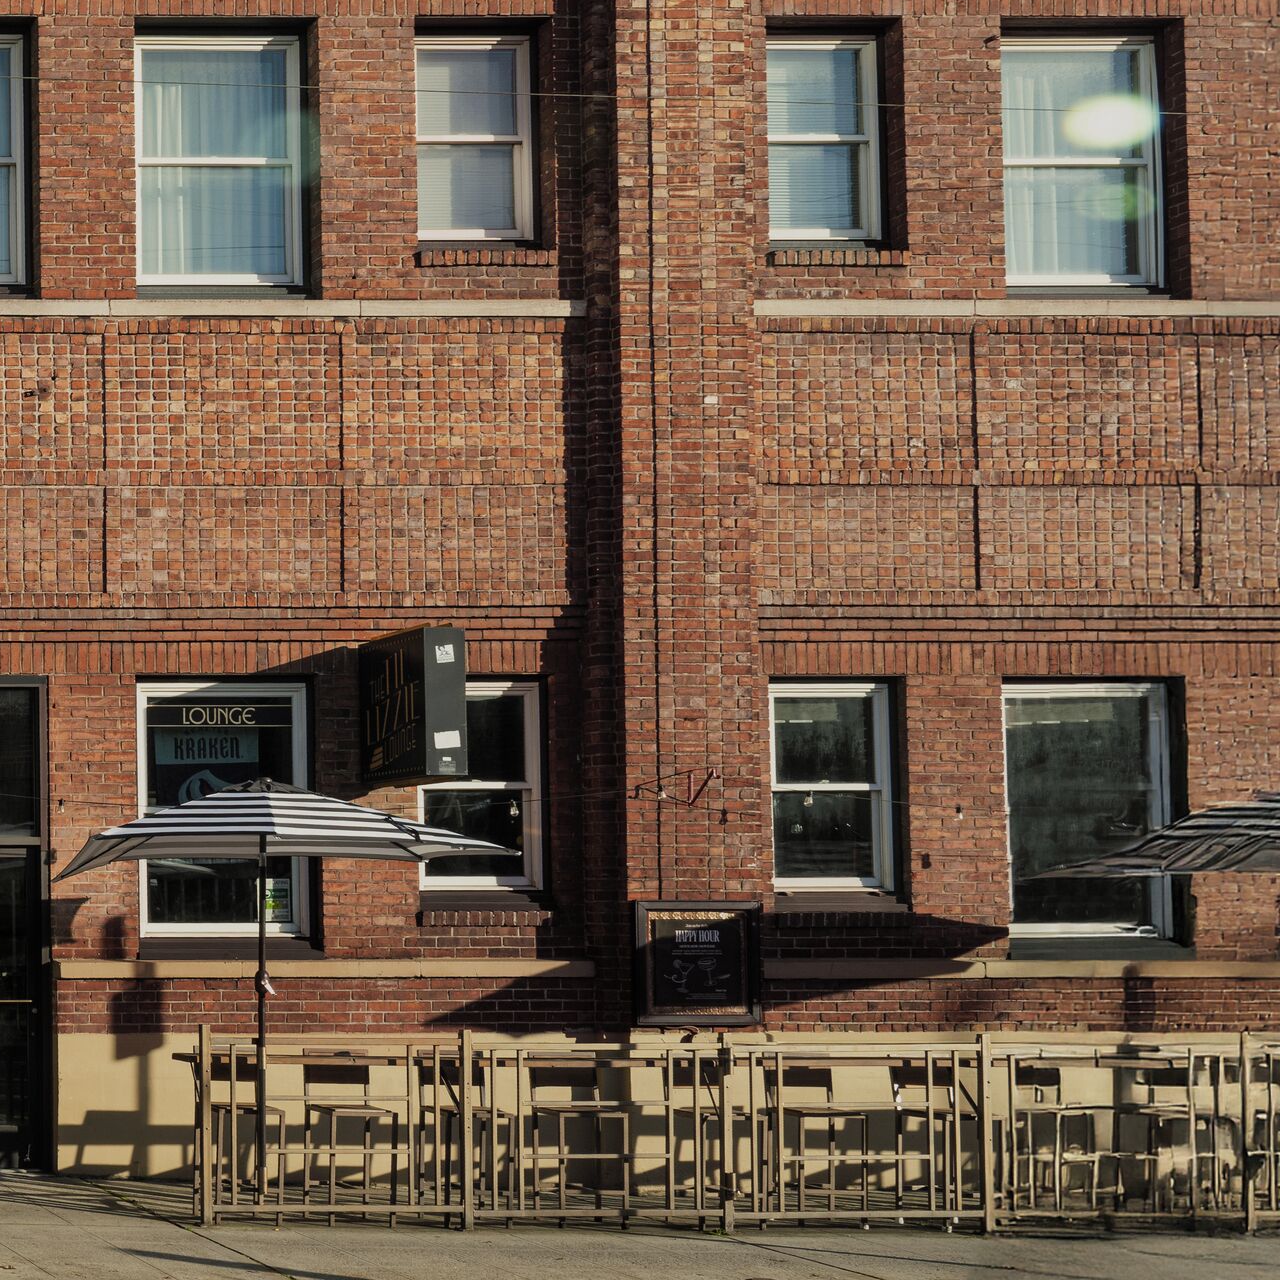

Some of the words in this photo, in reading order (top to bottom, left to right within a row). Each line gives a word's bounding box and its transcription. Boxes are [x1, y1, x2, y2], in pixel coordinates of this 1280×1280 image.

[182, 707, 256, 725] LOUNGE
[675, 929, 698, 942] HAPPY
[698, 929, 720, 942] HOUR
